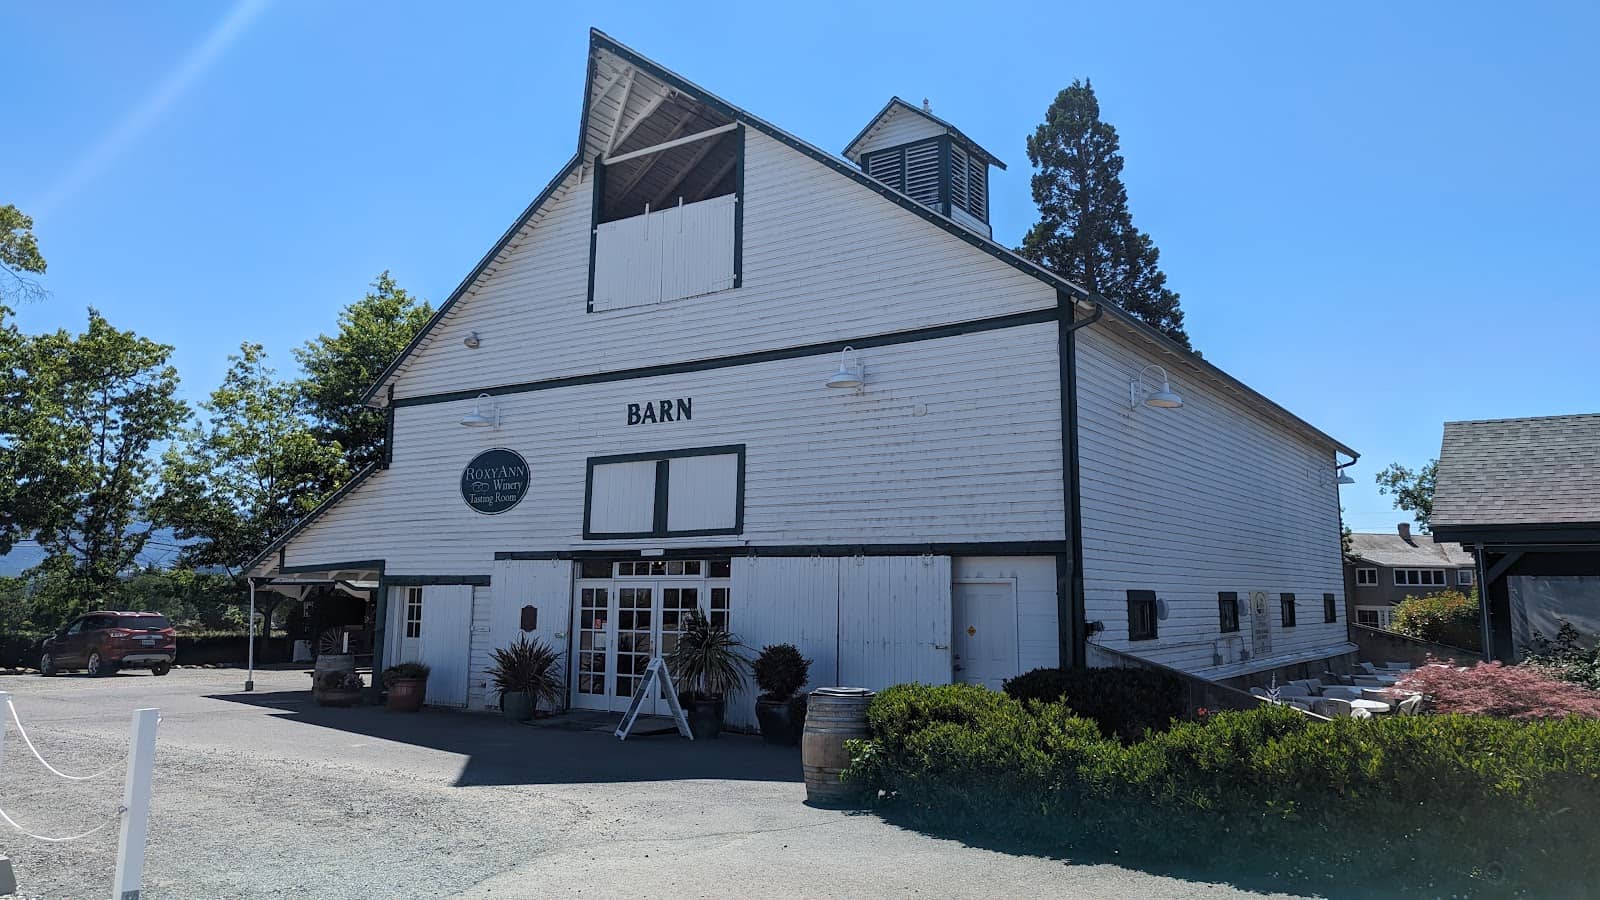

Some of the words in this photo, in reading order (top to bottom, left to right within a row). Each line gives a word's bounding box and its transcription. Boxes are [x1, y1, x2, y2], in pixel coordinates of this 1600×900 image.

[627, 397, 692, 425] BARN
[493, 479, 522, 493] Winery
[469, 493, 493, 505] Tasting
[495, 492, 517, 502] Room
